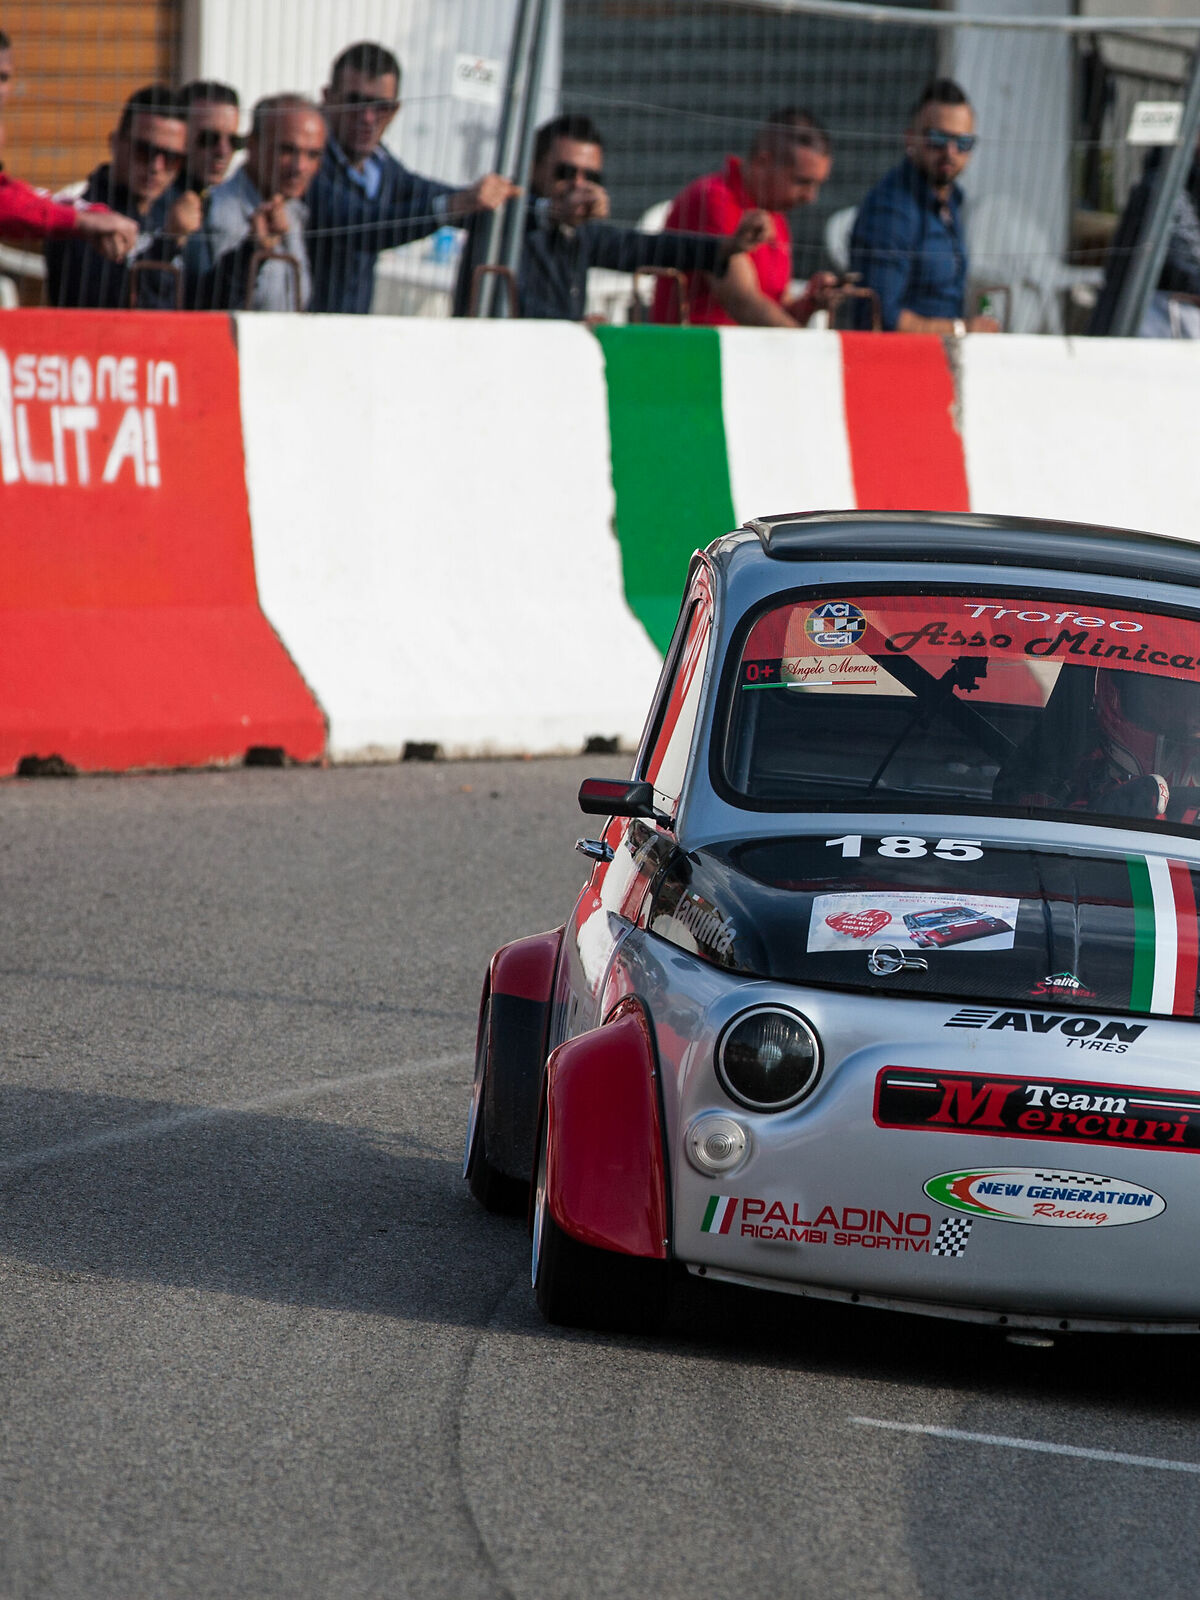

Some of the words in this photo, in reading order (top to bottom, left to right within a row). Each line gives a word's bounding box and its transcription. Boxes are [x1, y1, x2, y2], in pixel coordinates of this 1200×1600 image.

[818, 603, 850, 617] ACI
[964, 604, 1144, 632] Trofeo
[885, 621, 1012, 653] Asso
[781, 658, 825, 681] Angelo
[825, 834, 984, 862] 185
[1045, 976, 1080, 989] Salita
[987, 1012, 1149, 1043] AVON
[1066, 1038, 1129, 1054] TYRES
[926, 1079, 1190, 1143] Mercuri
[1024, 1085, 1127, 1115] Team
[976, 1181, 1023, 1197] NEW
[1026, 1185, 1154, 1206] GENERATION
[741, 1197, 932, 1237] PALADINO
[1033, 1202, 1109, 1225] Racing
[740, 1223, 827, 1245] RICAMBI
[833, 1232, 930, 1253] SPORTIVI
